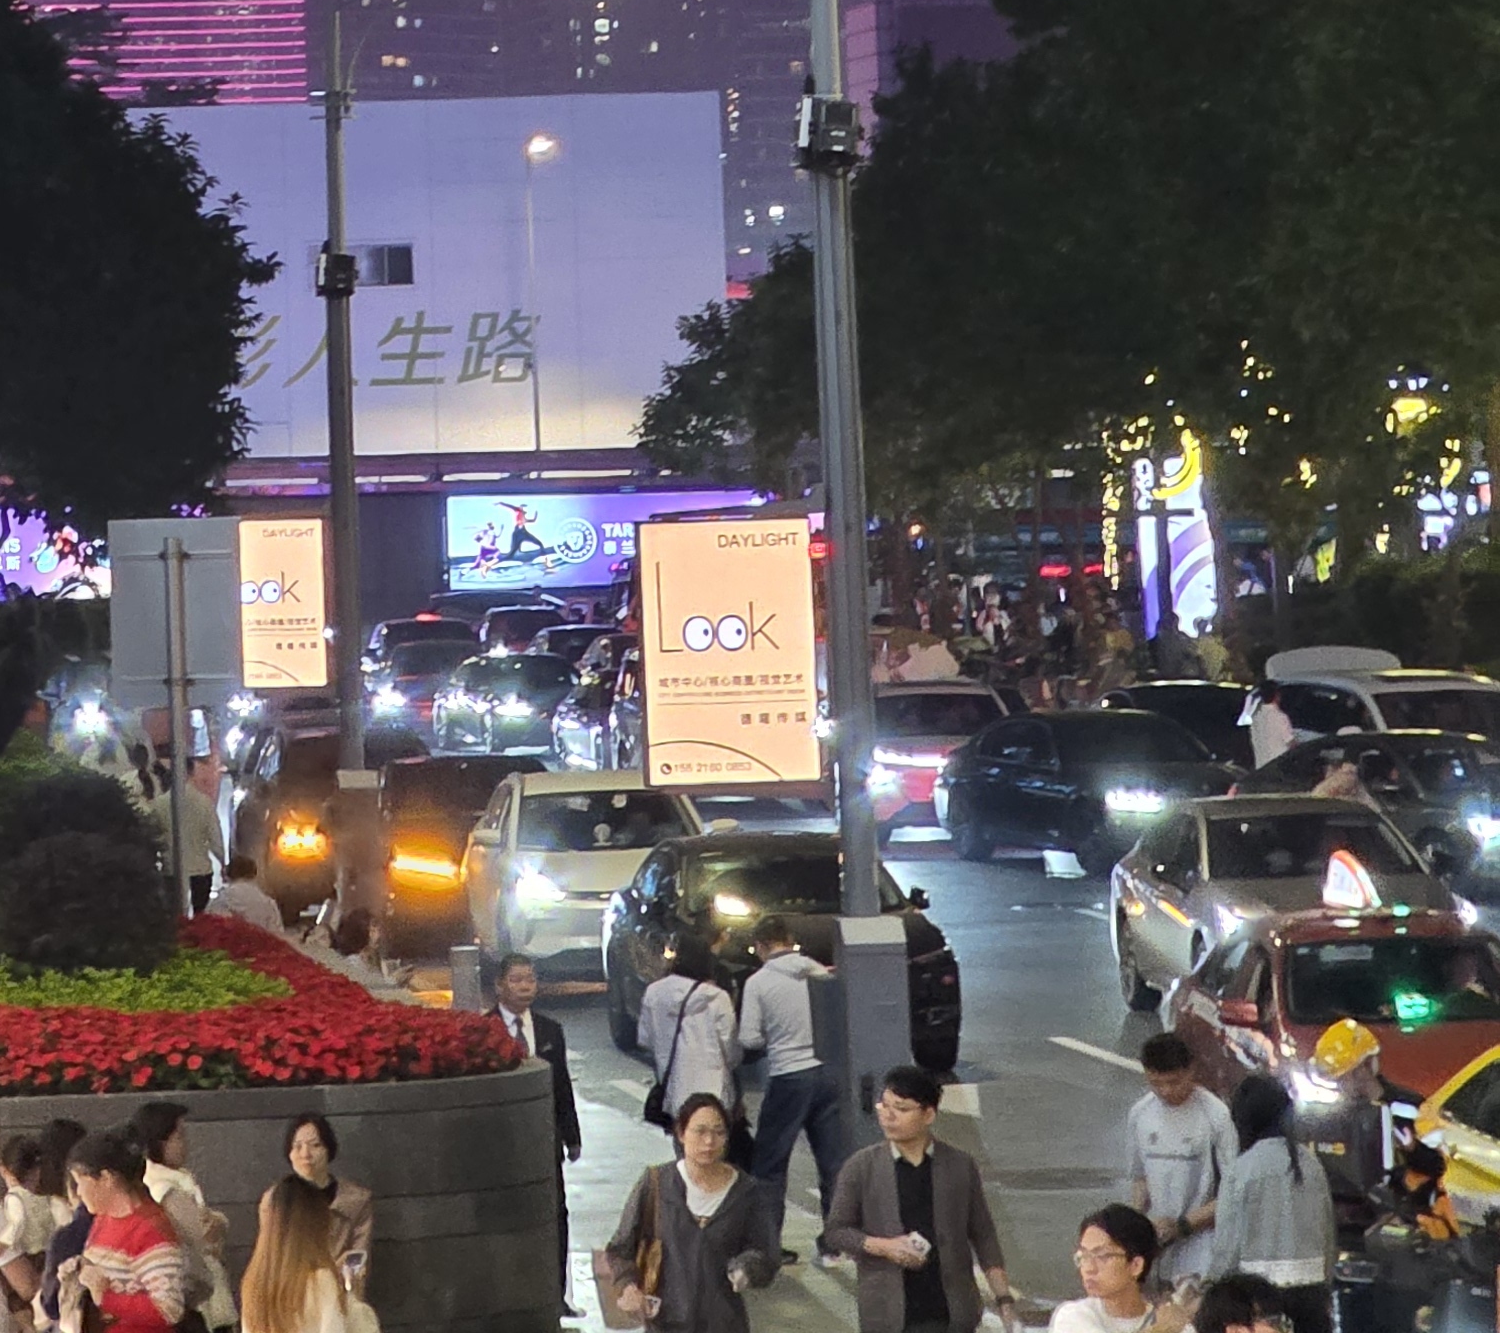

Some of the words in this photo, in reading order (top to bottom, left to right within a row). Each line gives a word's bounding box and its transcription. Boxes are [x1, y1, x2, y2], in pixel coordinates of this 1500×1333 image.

[717, 532, 800, 550] DAYLIGHT
[241, 571, 301, 605] ook
[655, 561, 781, 653] Look
